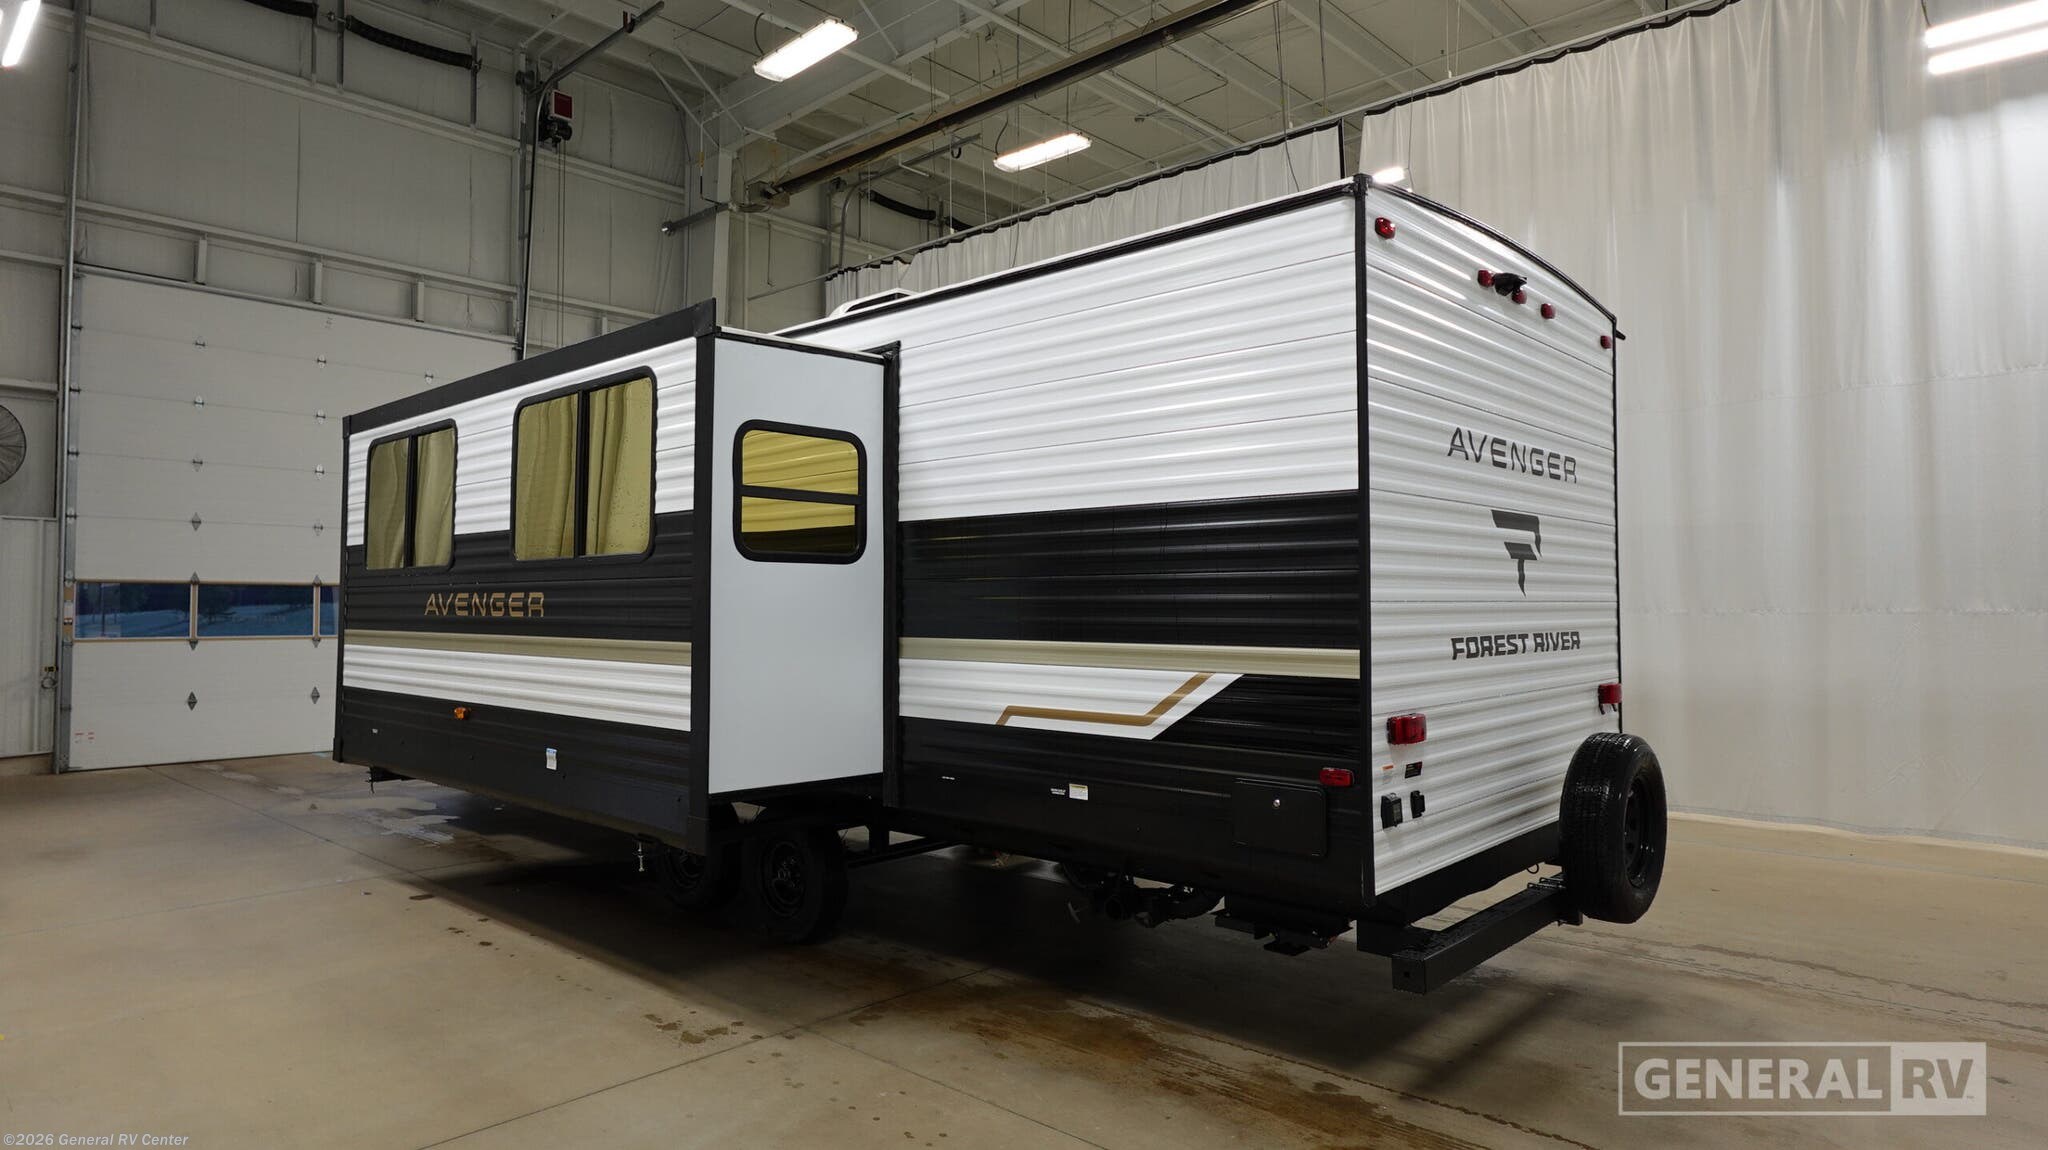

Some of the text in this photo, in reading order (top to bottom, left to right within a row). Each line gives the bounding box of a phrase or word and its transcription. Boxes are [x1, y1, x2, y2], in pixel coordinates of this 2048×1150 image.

[1448, 427, 1577, 484] AVENGER
[424, 592, 545, 618] AVENGER
[1451, 631, 1581, 661] FOREST RIVER
